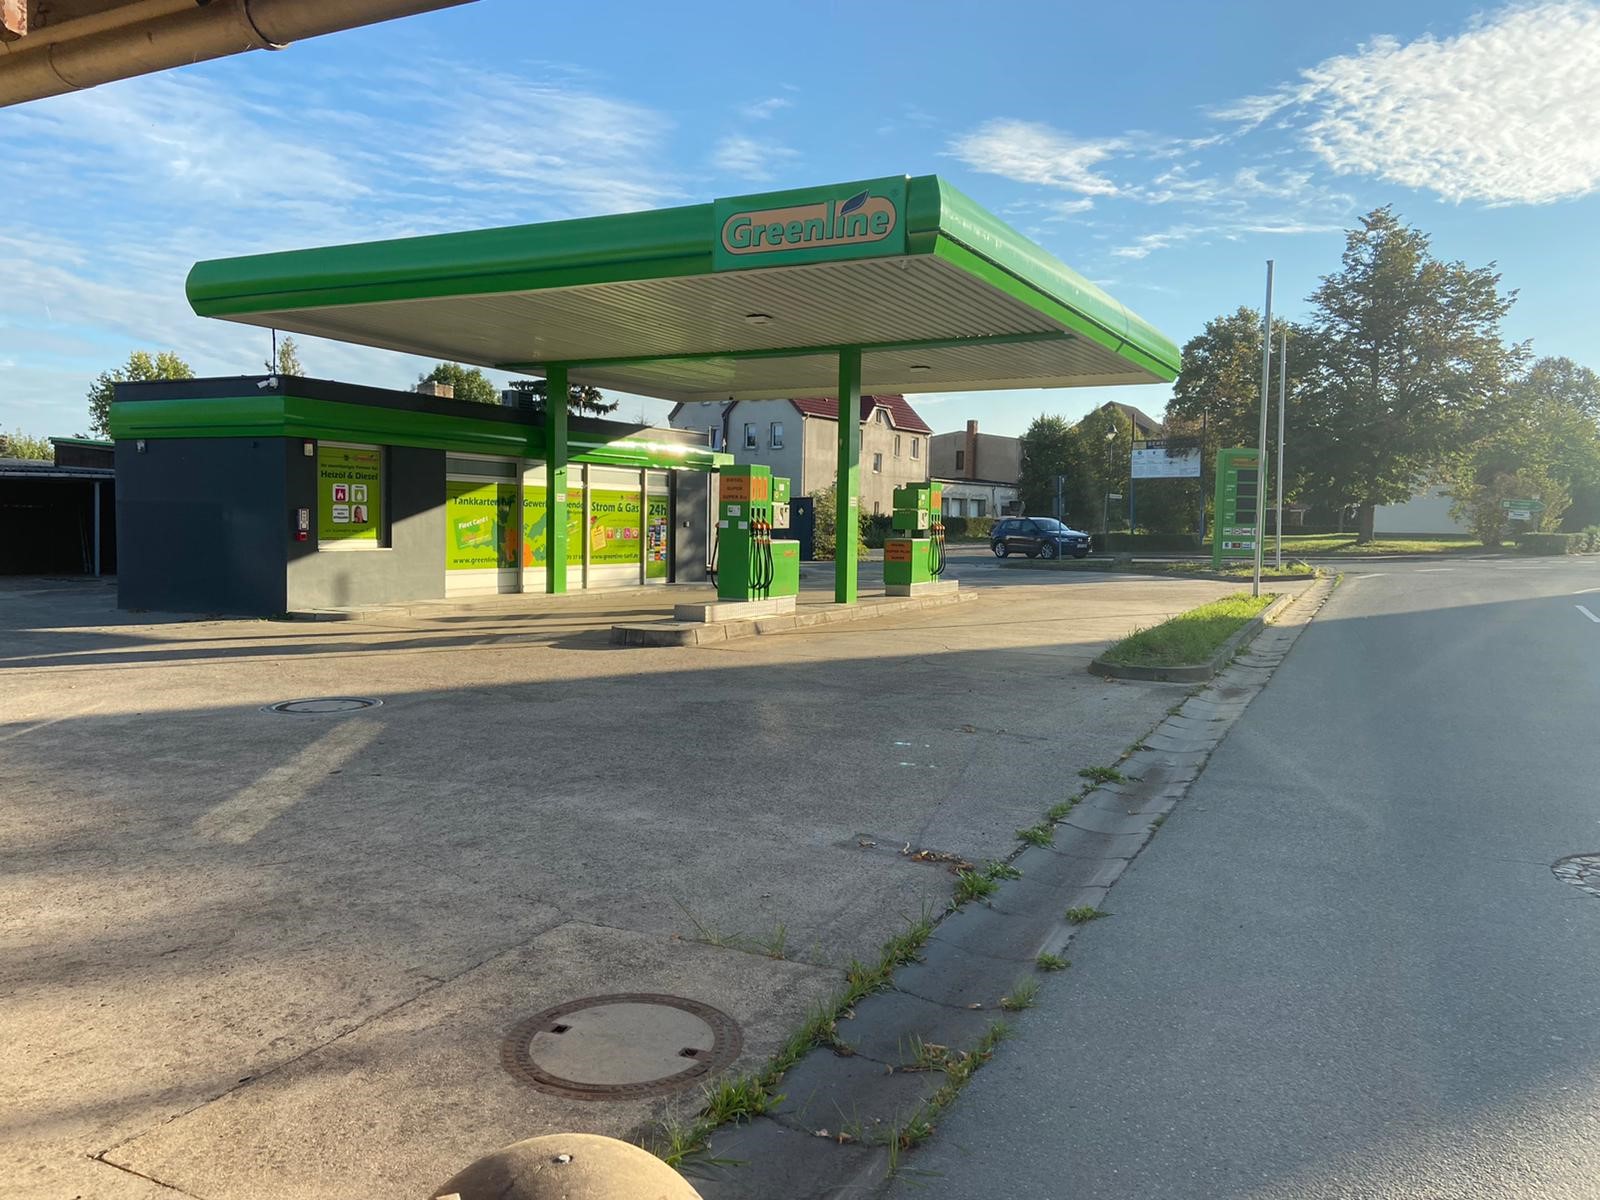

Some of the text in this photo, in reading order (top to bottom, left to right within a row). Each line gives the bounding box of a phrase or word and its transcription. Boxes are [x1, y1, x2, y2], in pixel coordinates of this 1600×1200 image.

[726, 199, 890, 249] Greenline
[355, 472, 378, 480] Diesel
[591, 501, 616, 512] Strom
[617, 502, 624, 512] &
[625, 502, 639, 512] Gas
[649, 504, 667, 516] 24h
